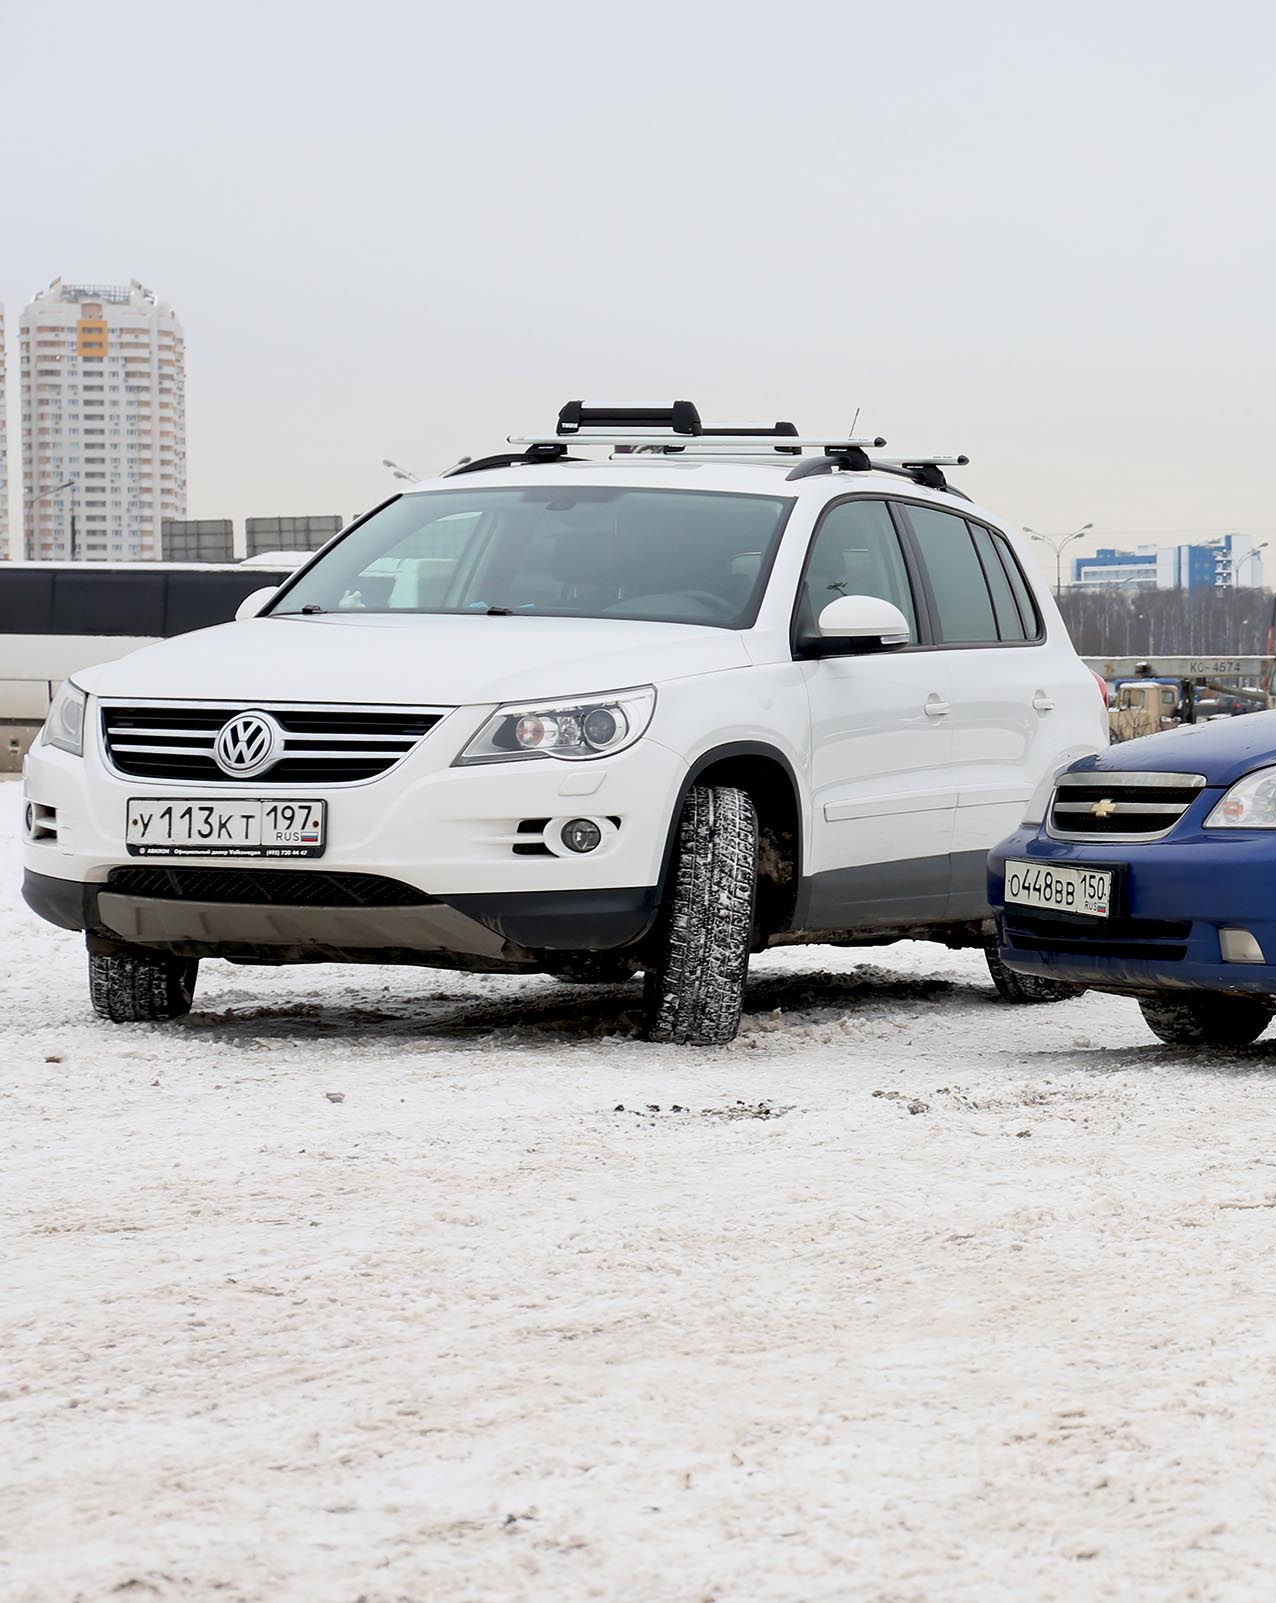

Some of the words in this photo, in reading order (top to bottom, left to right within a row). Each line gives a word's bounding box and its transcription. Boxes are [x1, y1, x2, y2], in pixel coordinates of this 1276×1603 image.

[266, 805, 312, 831] 197
[275, 831, 300, 842] RUS
[1080, 874, 1105, 900] 150
[1085, 900, 1098, 911] RUS
